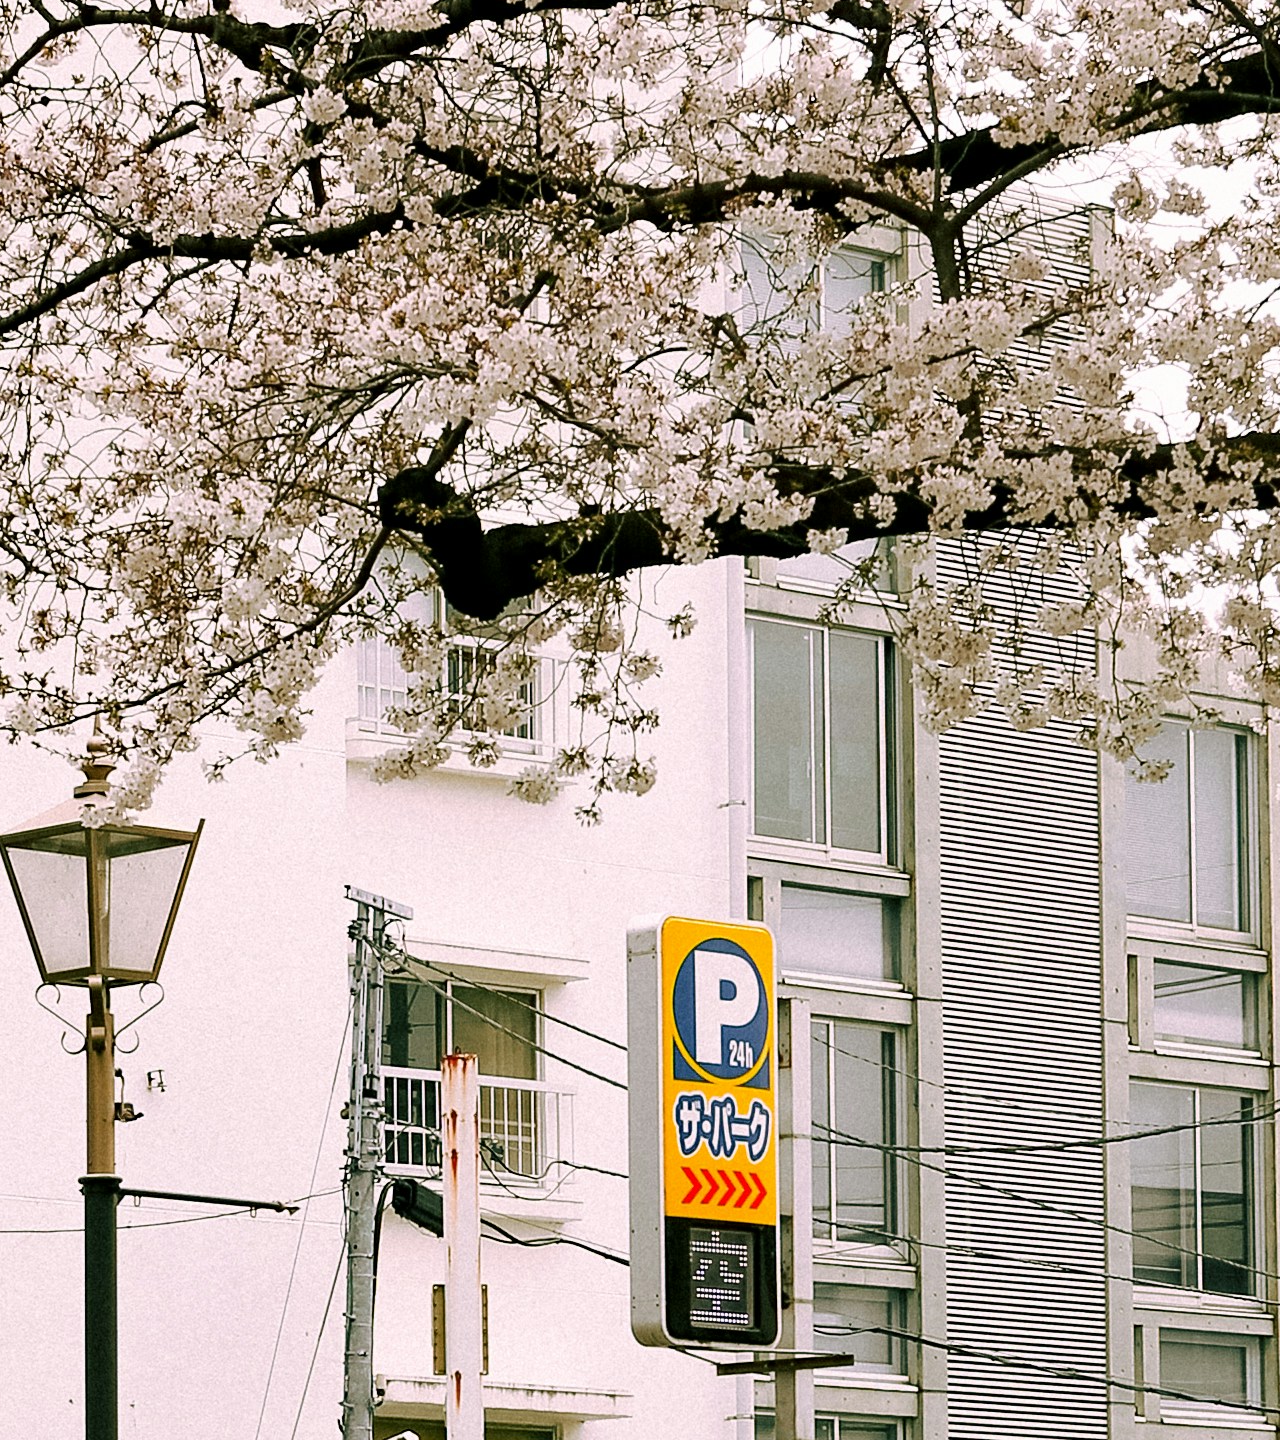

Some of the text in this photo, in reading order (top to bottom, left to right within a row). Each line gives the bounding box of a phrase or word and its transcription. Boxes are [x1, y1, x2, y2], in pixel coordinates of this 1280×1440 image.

[695, 949, 761, 1065] P
[728, 1039, 755, 1071] 24h
[675, 1095, 770, 1162] ザ・パーク
[690, 1230, 749, 1326] 空
